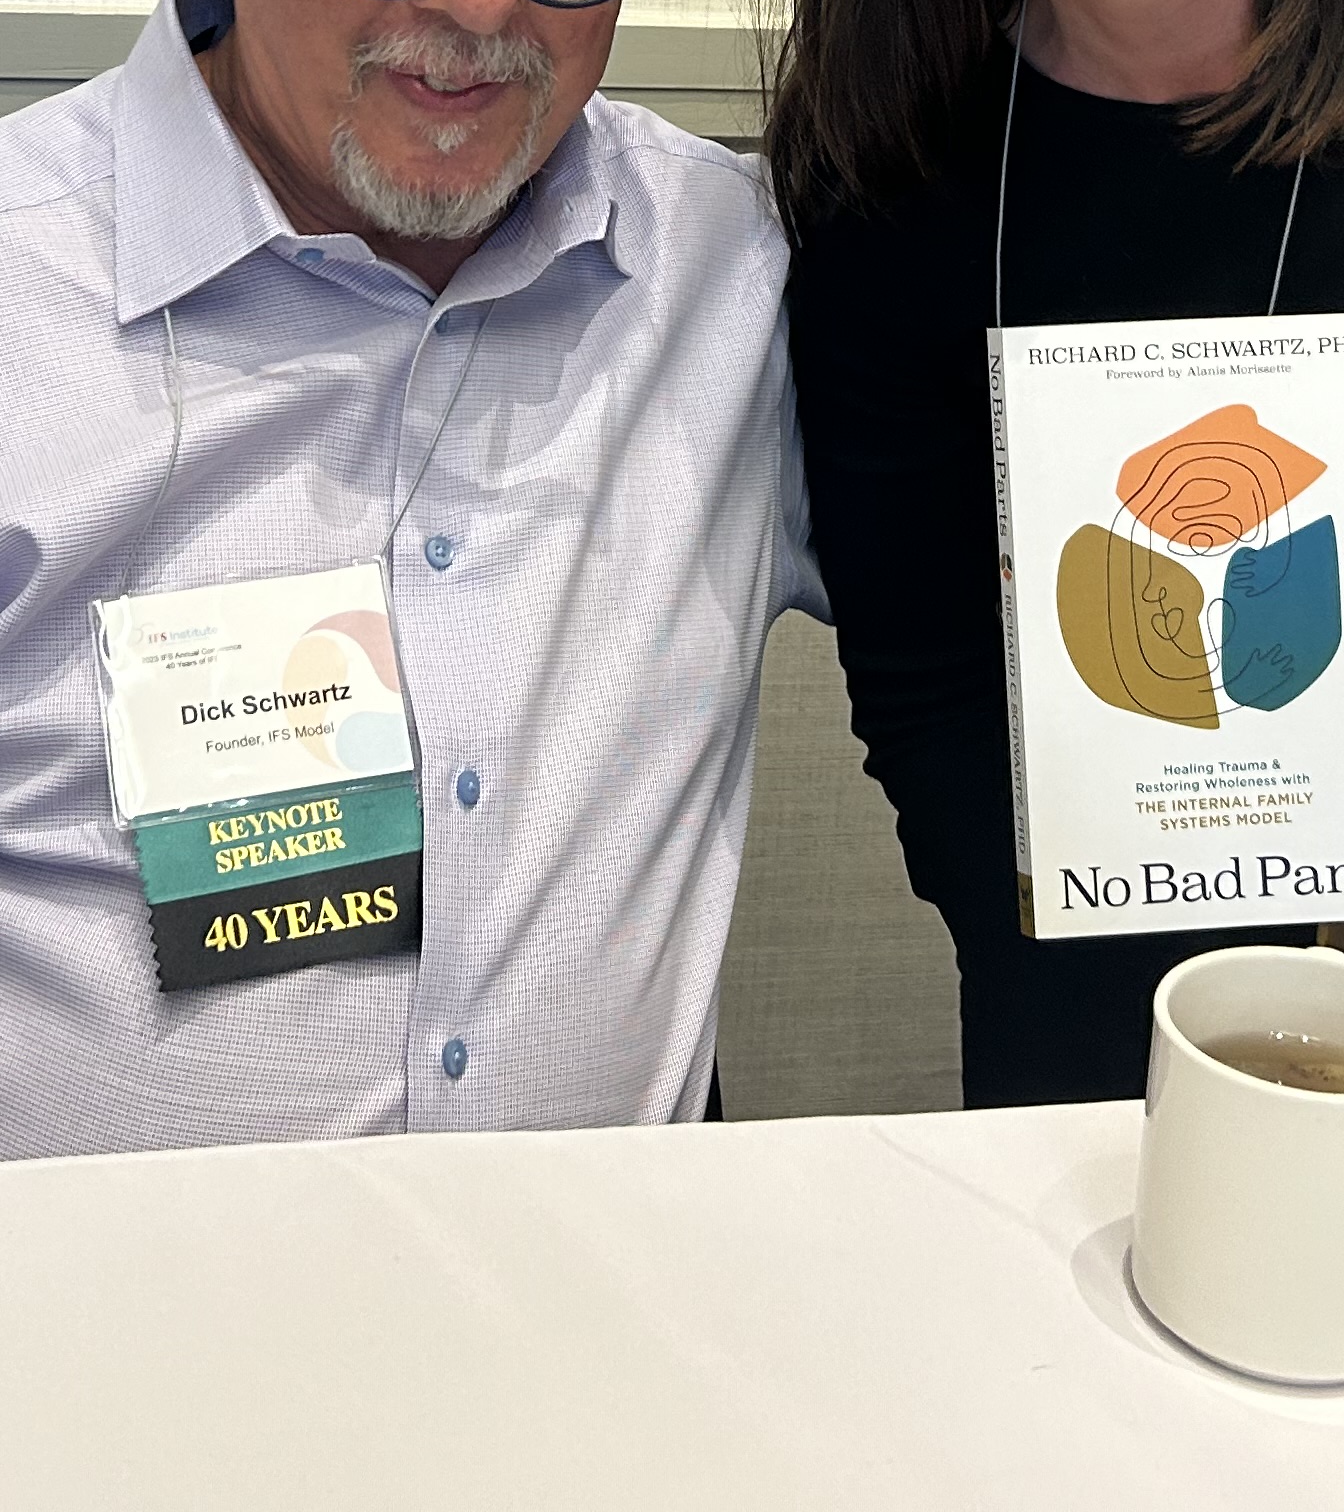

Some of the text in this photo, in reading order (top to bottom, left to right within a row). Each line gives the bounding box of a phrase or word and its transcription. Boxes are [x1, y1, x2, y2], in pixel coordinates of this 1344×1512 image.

[1028, 344, 1136, 365] RICHARD
[1144, 343, 1165, 361] C.
[1171, 338, 1312, 359] SCHWARTZ,
[1106, 362, 1292, 380] Foreword by Alanis Morissette
[989, 355, 1009, 537] No Bad Parts
[1005, 594, 1016, 677] RICHARD
[181, 683, 352, 725] Dick Schwartz
[206, 722, 335, 753] Founder, IFS Model
[1135, 772, 1311, 794] Restoring Wholeness with
[1164, 758, 1281, 775] Healing Trauma &
[1135, 791, 1314, 814] THE INTERNAL FAMILY
[208, 798, 343, 845] KEYNOTE
[1160, 811, 1293, 831] SYSTEMS MODEL
[215, 827, 346, 874] SPEAKER
[1059, 866, 1131, 910] No
[1139, 856, 1246, 905] Bad
[205, 885, 399, 952] 40 YEARS
